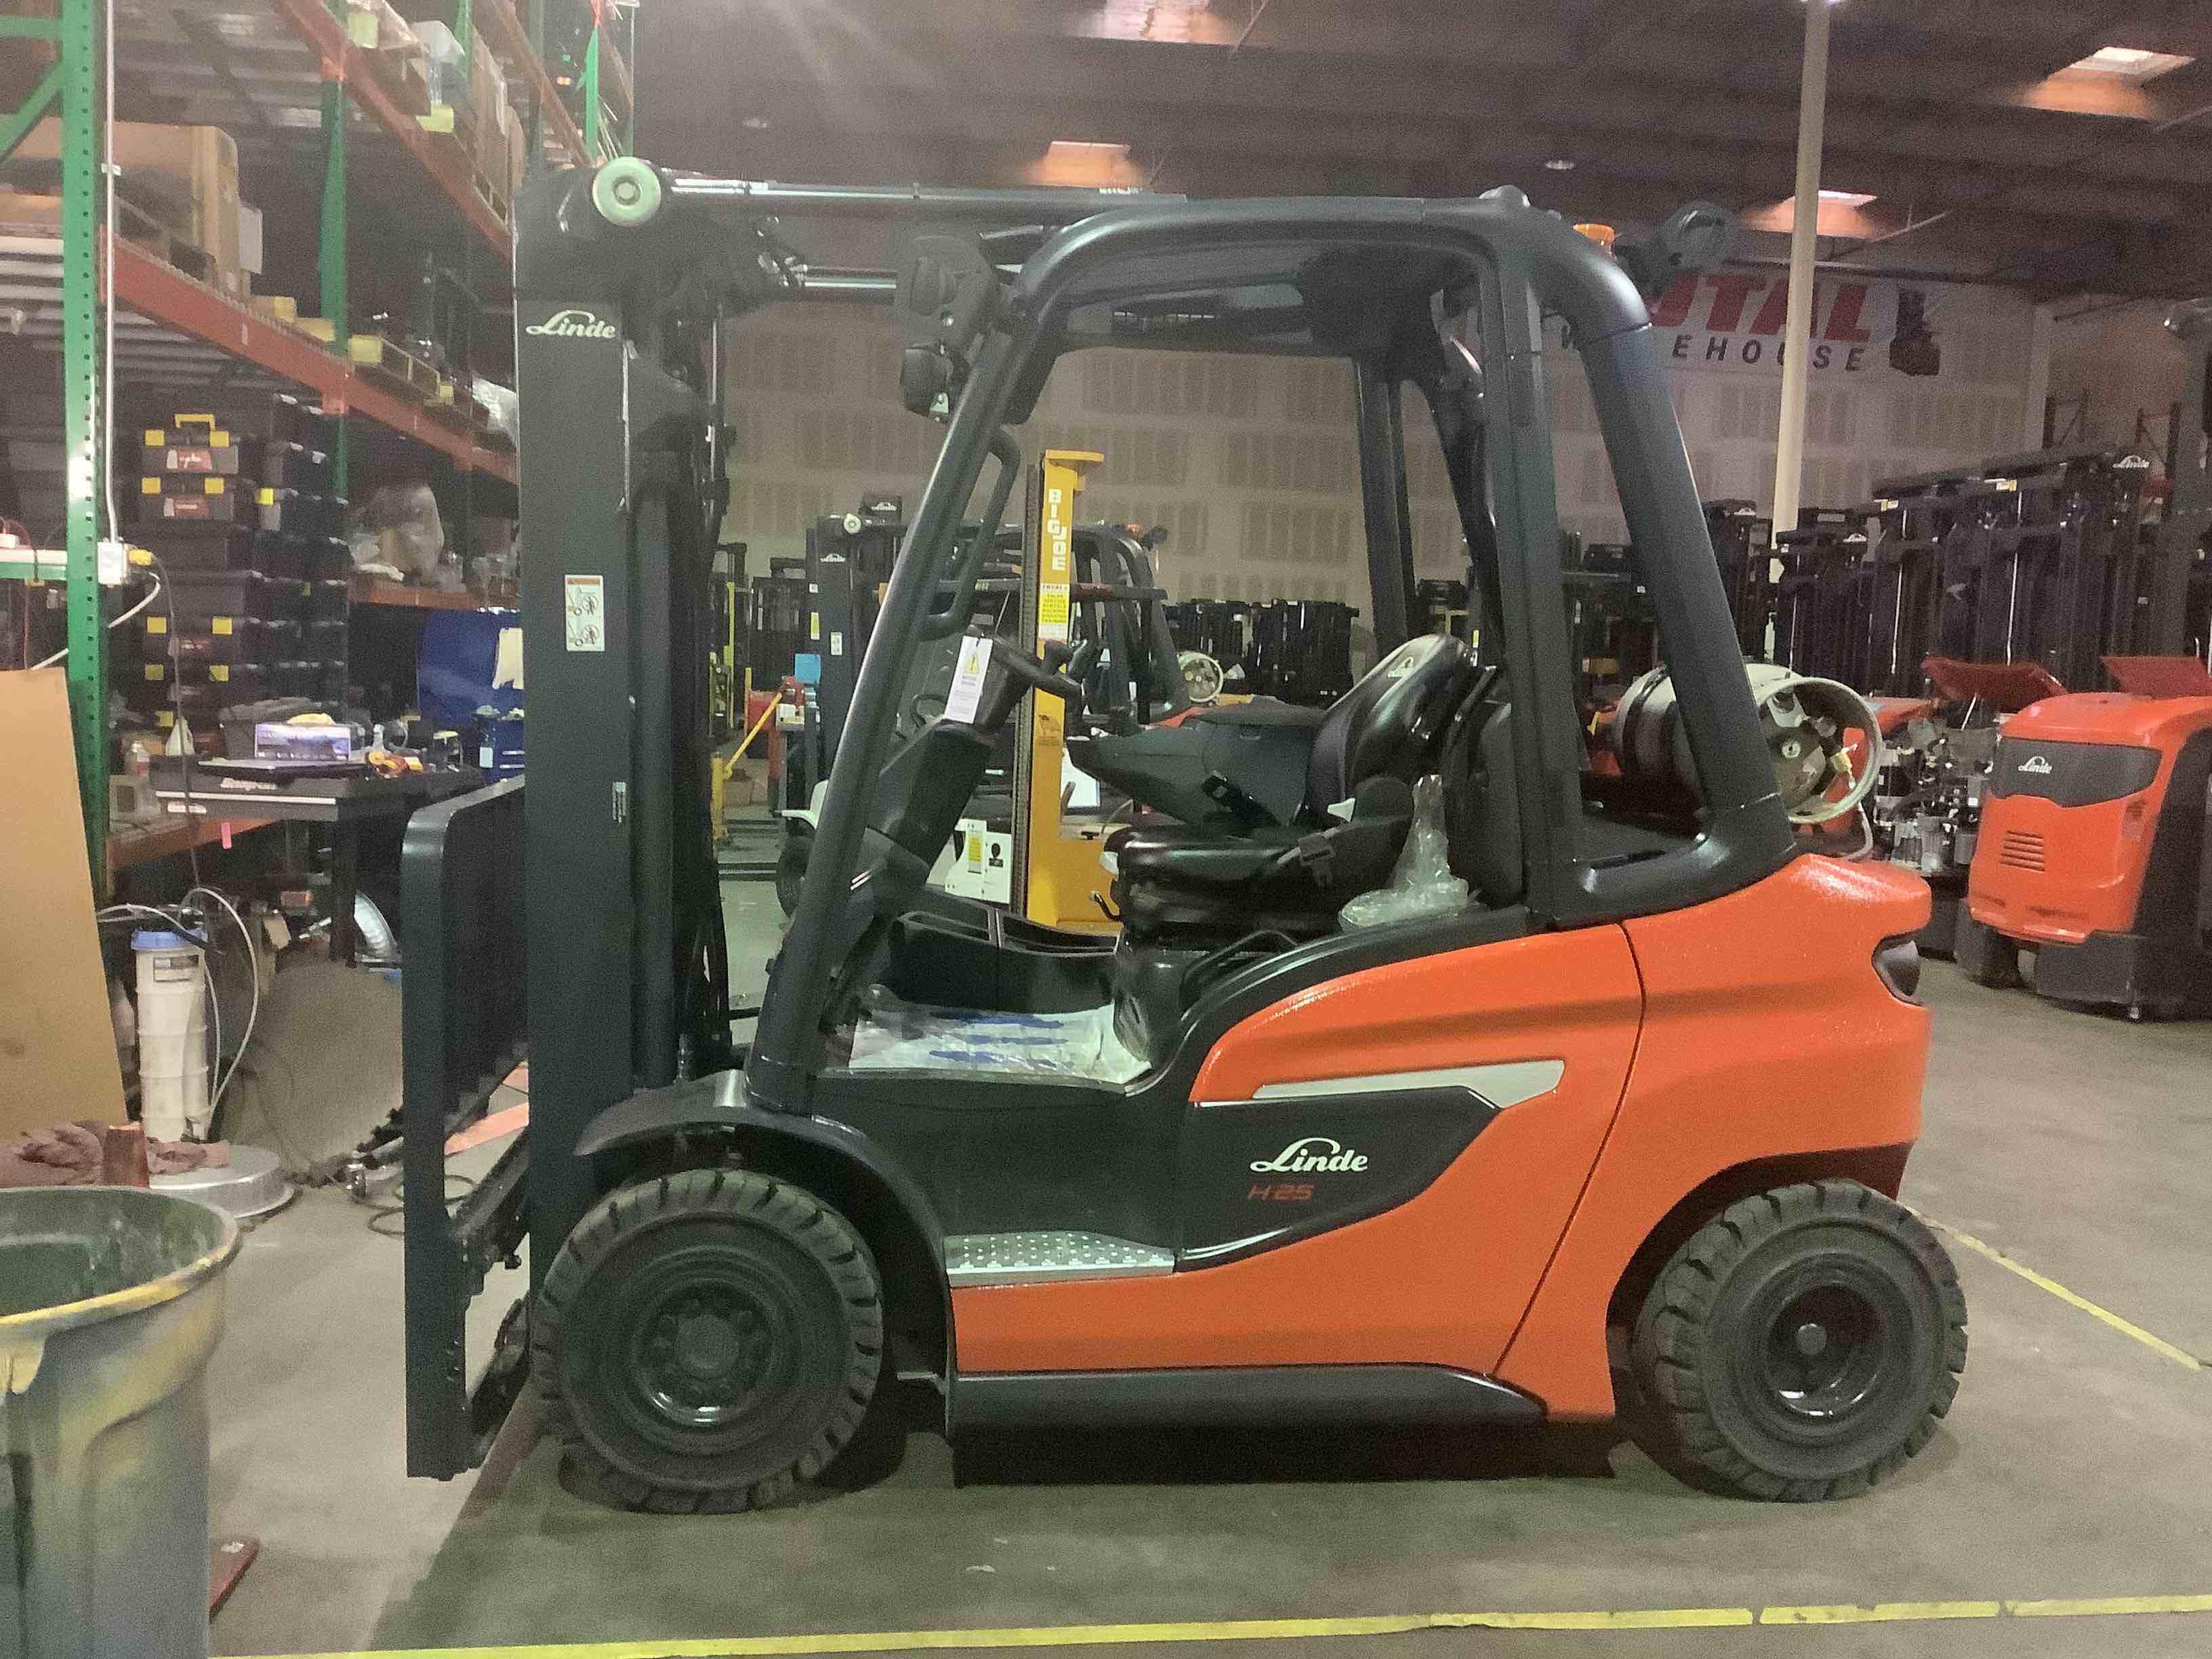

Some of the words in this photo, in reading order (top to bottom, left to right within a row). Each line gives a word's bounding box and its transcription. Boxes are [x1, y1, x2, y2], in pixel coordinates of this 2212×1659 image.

[525, 310, 615, 338] Linde
[2018, 756, 2052, 774] Linde
[1250, 1137, 1368, 1172] Linde
